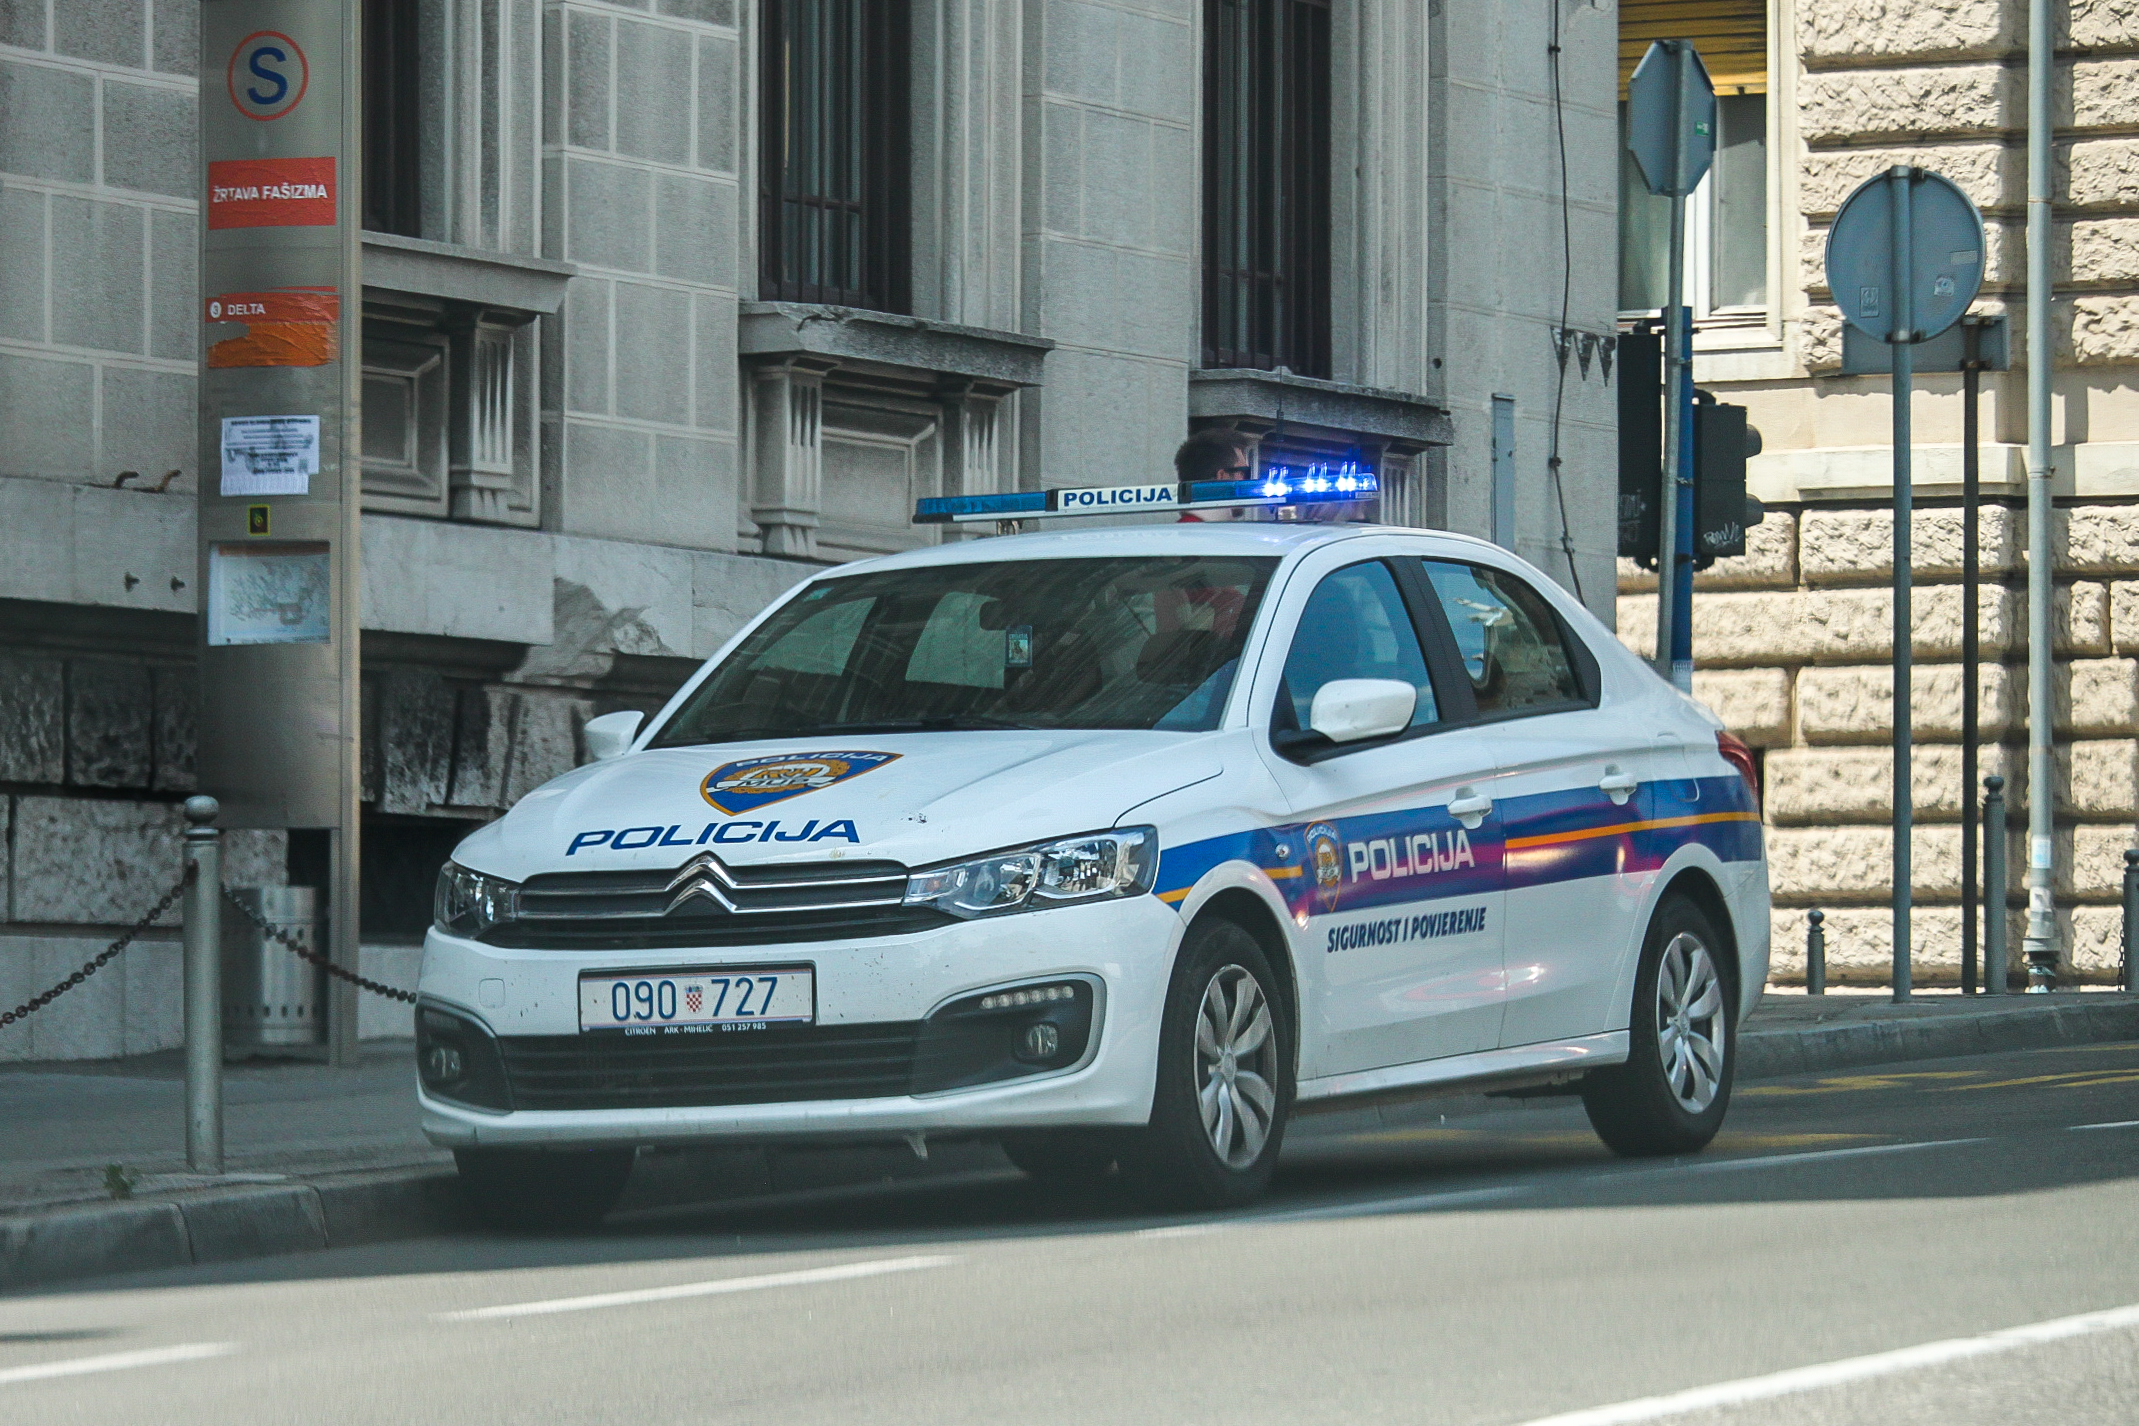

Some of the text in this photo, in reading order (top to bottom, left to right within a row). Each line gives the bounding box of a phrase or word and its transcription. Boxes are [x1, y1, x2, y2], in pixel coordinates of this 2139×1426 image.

[247, 46, 288, 105] S
[213, 182, 328, 203] ŽRTAVA FAŠIZMA
[227, 303, 266, 316] DELTA
[1063, 487, 1173, 507] POLICIJA
[735, 752, 889, 767] POLICIJA
[565, 819, 861, 856] POLICIJA
[1347, 829, 1476, 884] POLICIJA
[1326, 906, 1487, 953] SIGURNOST I POVJERENJE
[611, 976, 778, 1021] 090 727
[721, 1024, 735, 1032] 051
[737, 1023, 750, 1032] 257
[752, 1022, 767, 1030] 985
